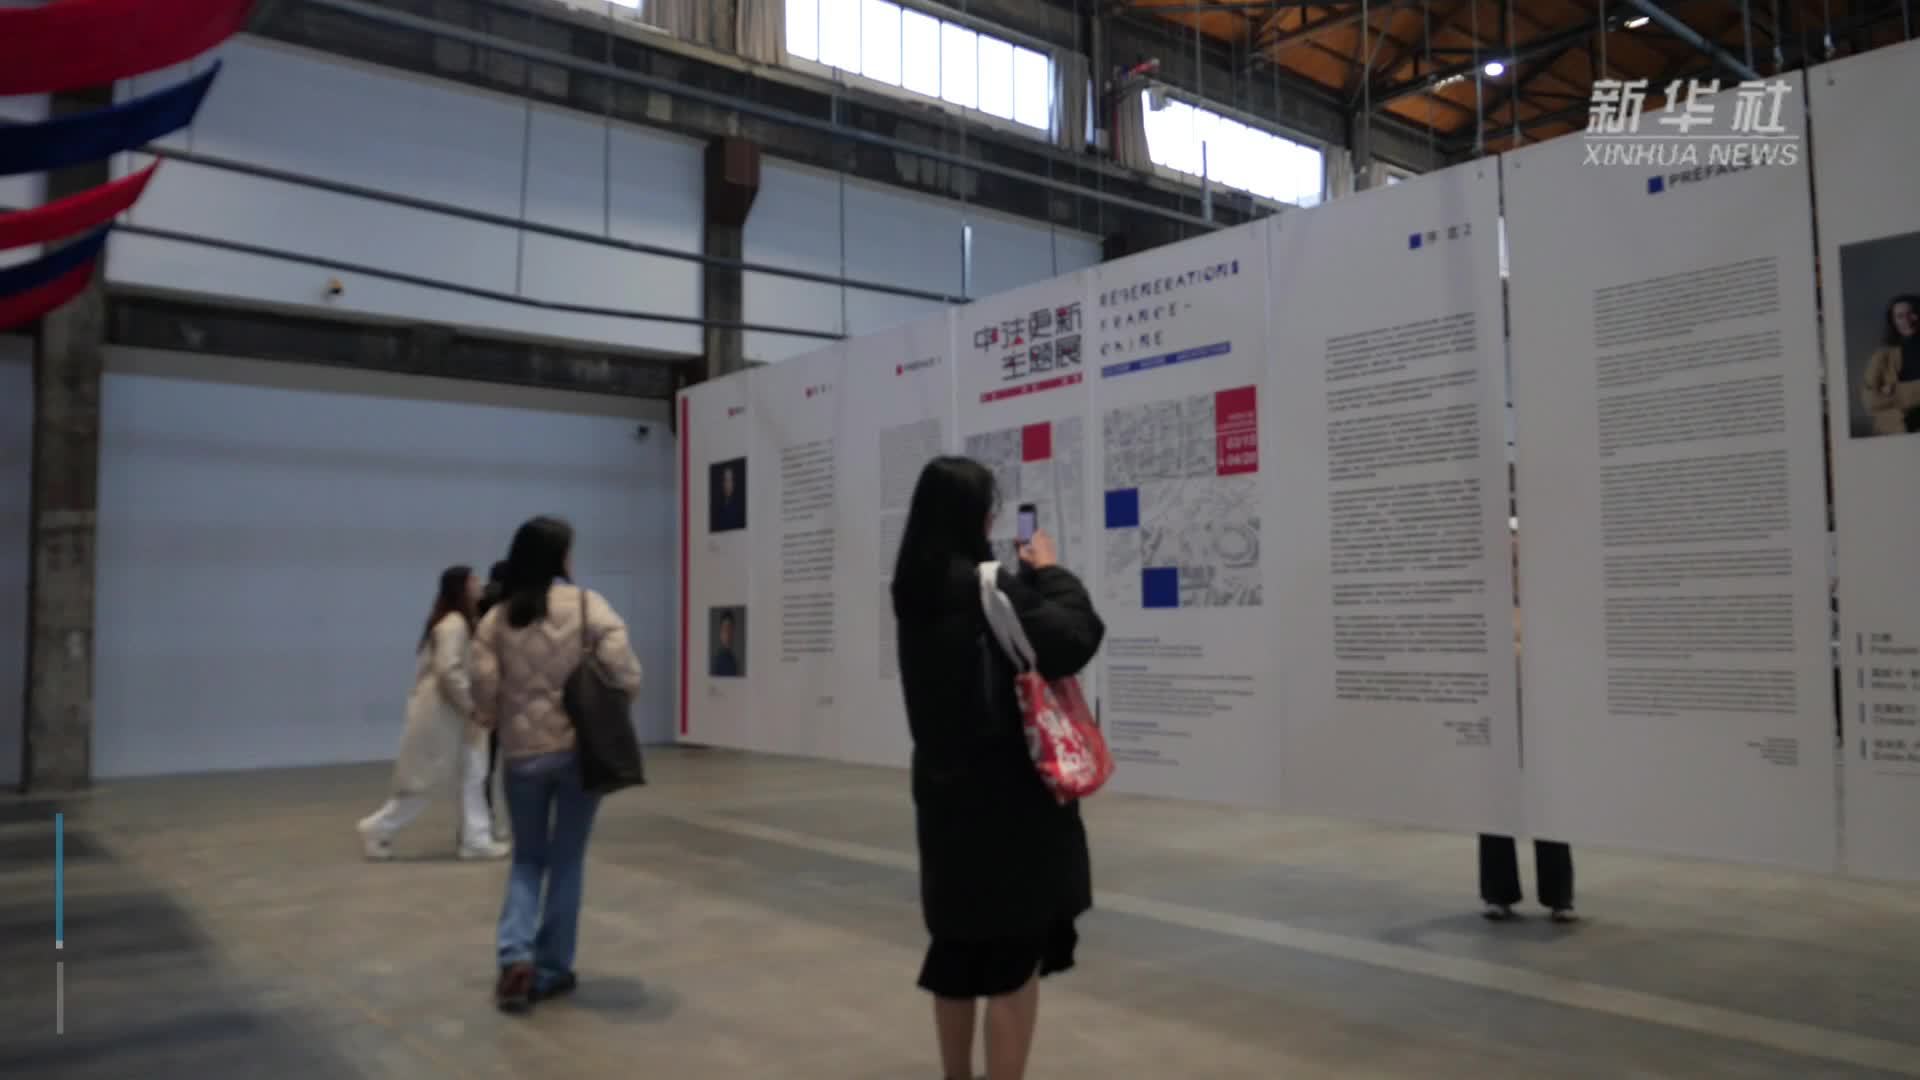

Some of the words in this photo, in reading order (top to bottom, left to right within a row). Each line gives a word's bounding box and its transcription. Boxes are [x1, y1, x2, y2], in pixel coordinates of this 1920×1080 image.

[974, 302, 1082, 353] 中法更新
[1001, 334, 1082, 381] 主题展
